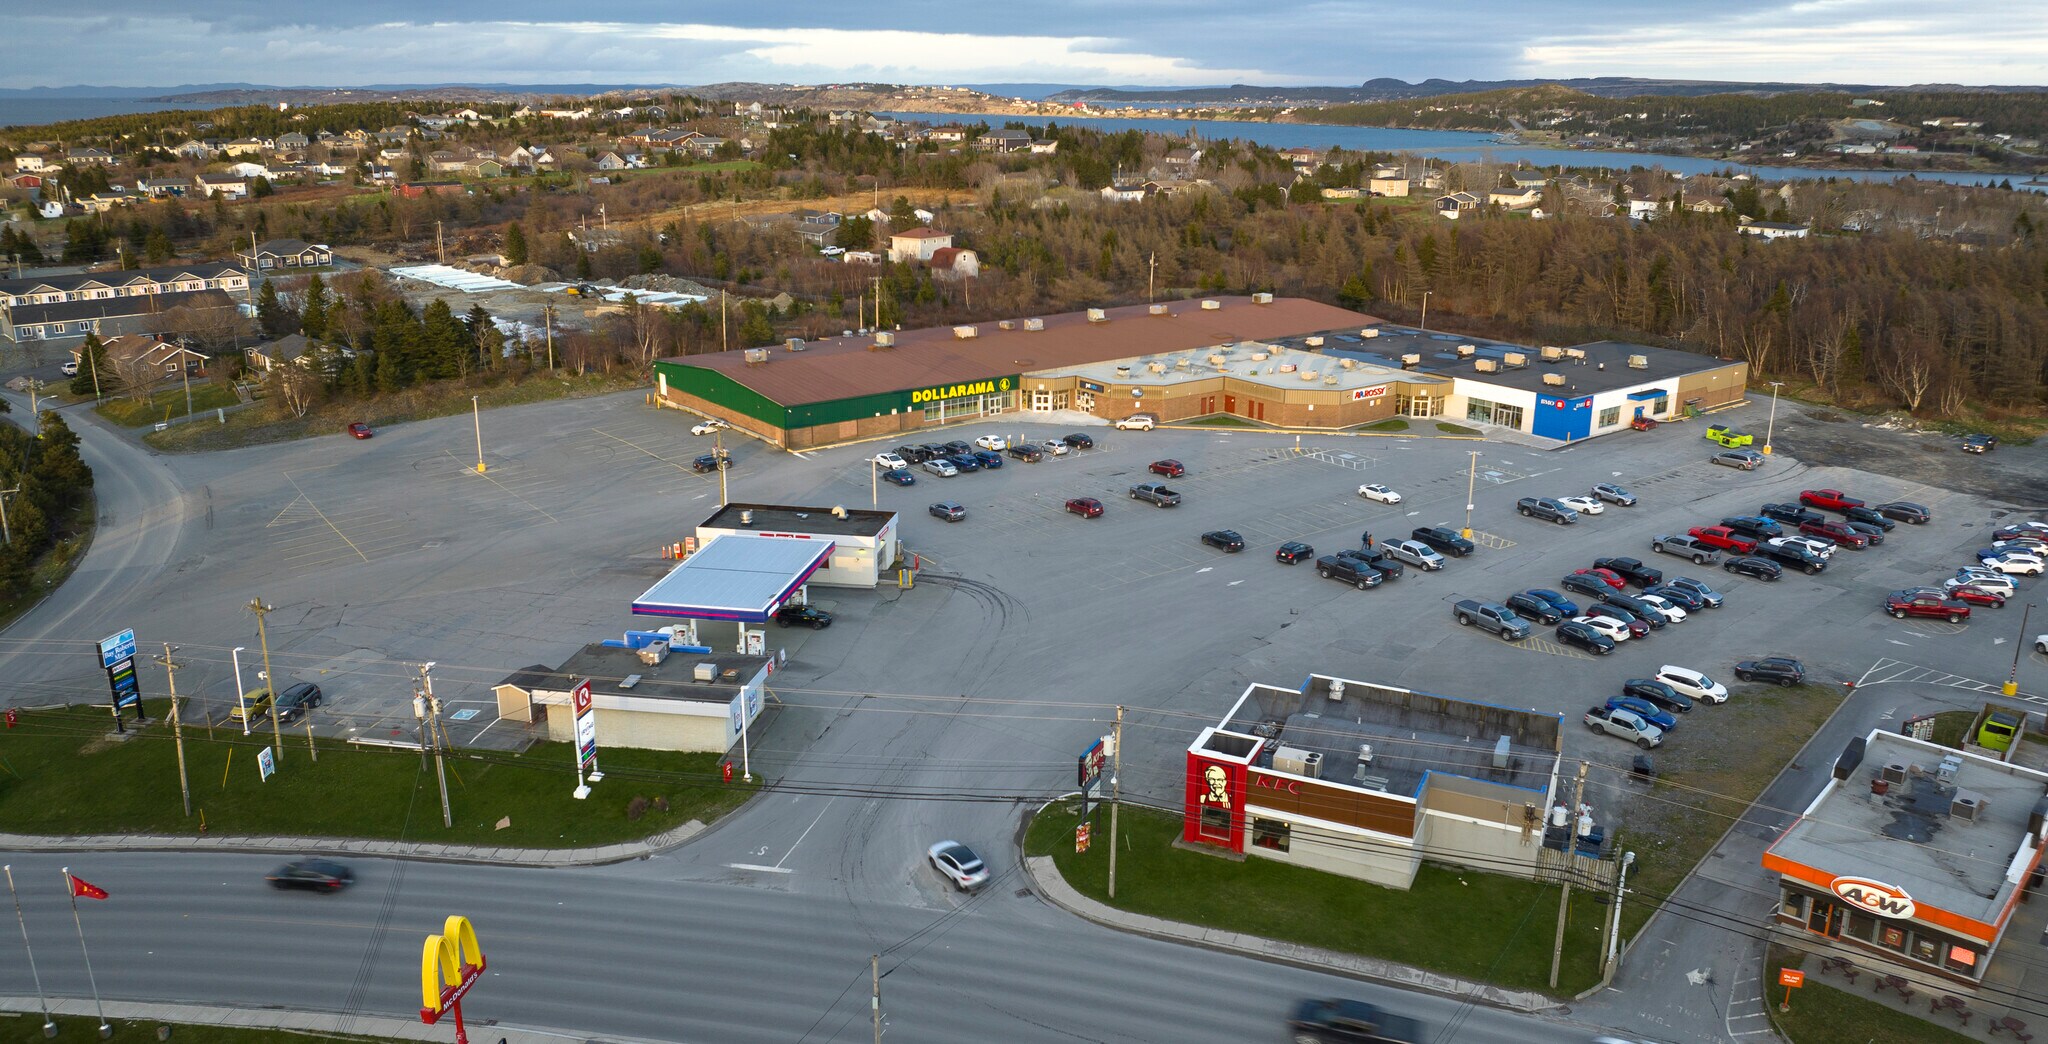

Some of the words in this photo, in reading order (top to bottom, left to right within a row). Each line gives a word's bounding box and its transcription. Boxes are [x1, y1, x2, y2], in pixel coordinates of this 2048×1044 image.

[912, 381, 995, 403] DOLLARAMA
[1256, 775, 1305, 795] KFC
[1841, 887, 1909, 915] A&W
[443, 971, 478, 1011] McDonald's
